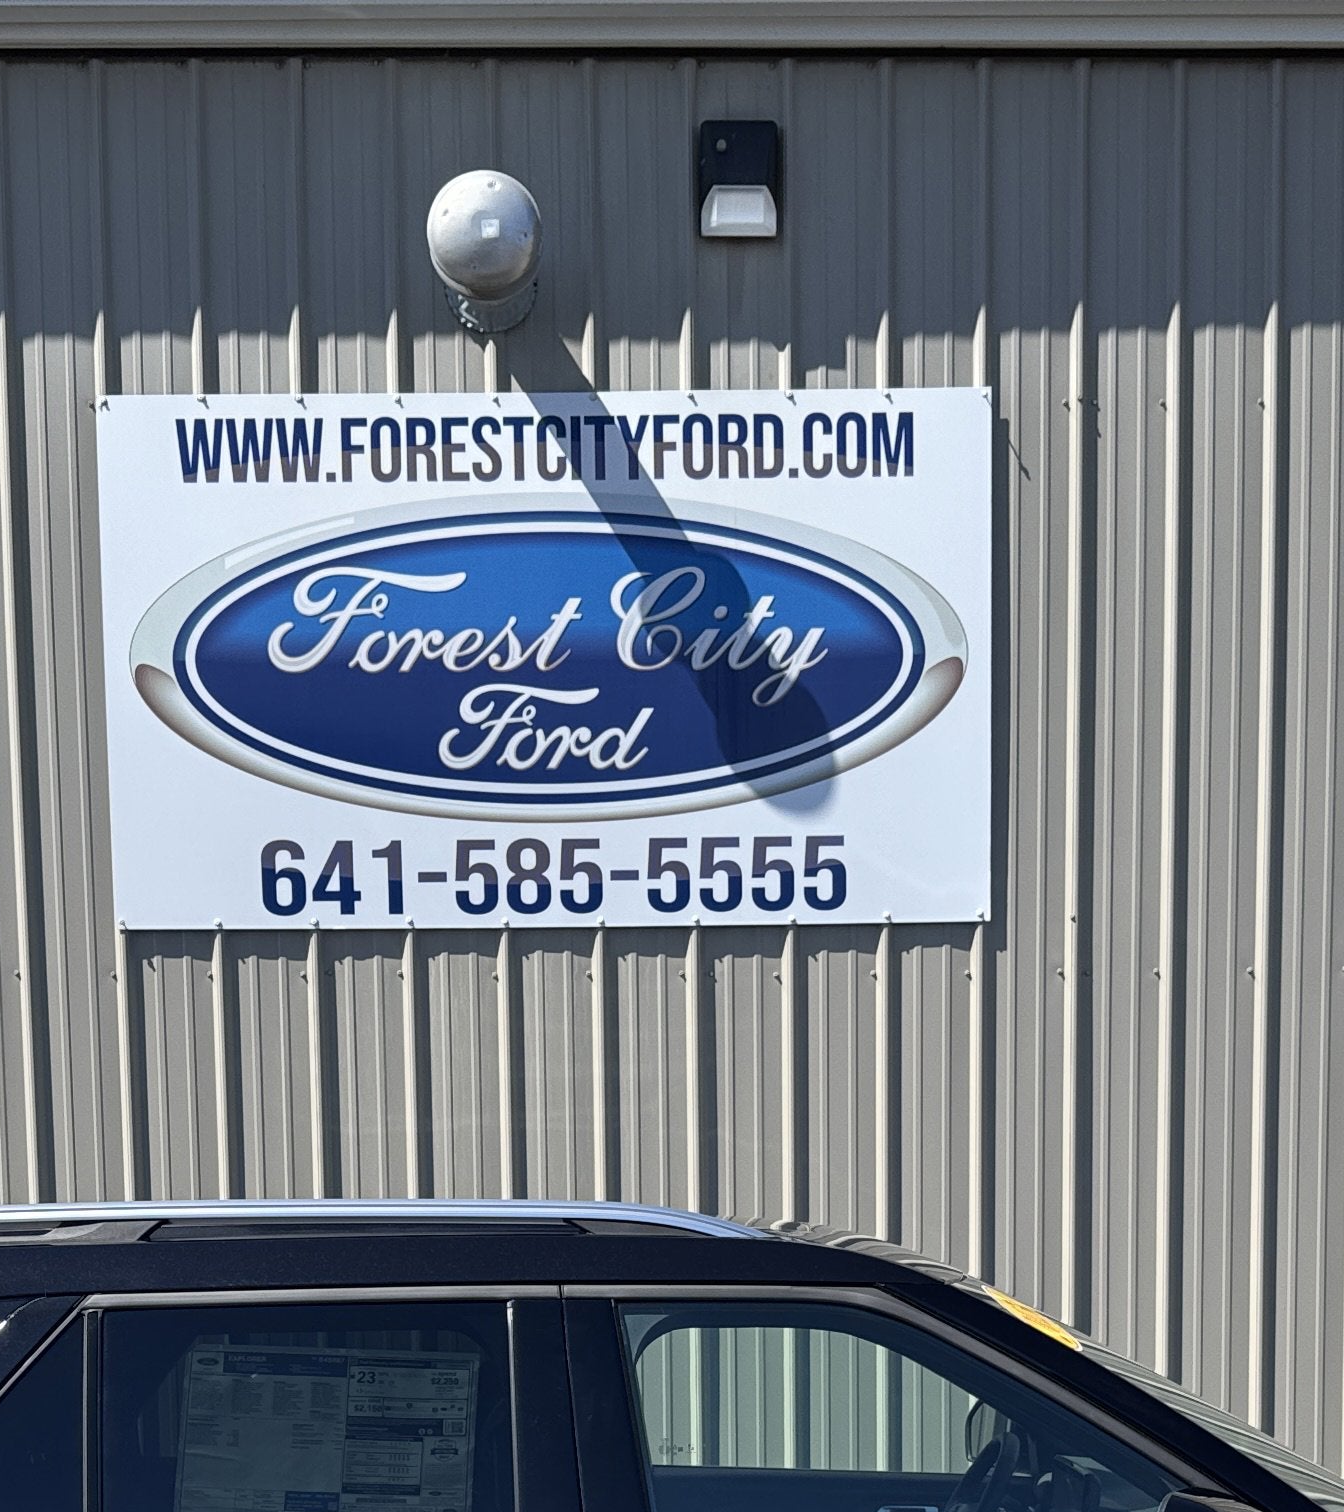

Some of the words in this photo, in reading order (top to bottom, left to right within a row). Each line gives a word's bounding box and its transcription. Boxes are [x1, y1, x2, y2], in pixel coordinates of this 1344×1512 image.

[174, 411, 916, 484] WWW.FORESTCITYFORD.COM
[266, 565, 582, 674] Forest
[609, 565, 828, 707] City
[438, 683, 653, 772] Ford
[259, 834, 847, 917] 641-585-5555
[356, 1371, 377, 1385] 23
